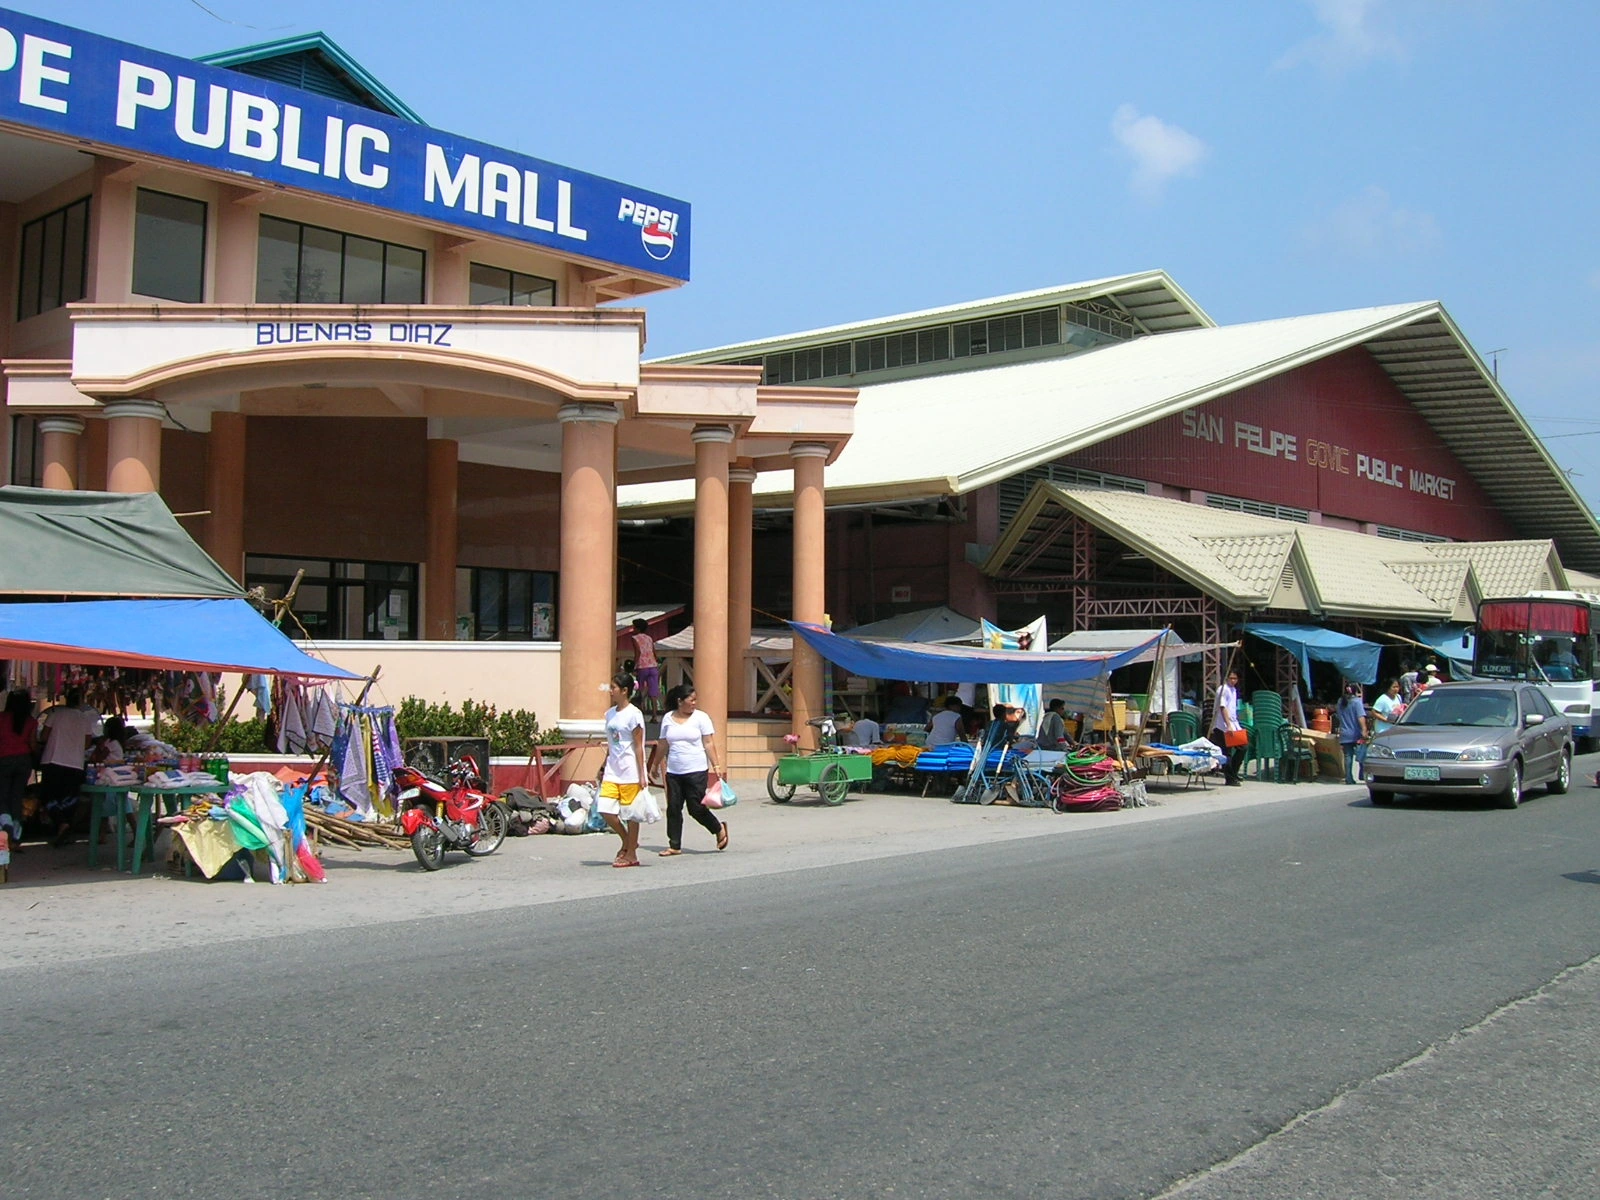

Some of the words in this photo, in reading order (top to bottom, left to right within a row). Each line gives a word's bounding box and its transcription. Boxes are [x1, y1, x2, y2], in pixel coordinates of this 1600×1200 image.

[116, 59, 390, 189] PUBLIC
[424, 143, 588, 241] MALL
[618, 197, 679, 236] PEPSI
[256, 322, 372, 346] BUENAS
[389, 323, 452, 347] DIAZ
[1182, 409, 1224, 444] SAN
[1234, 421, 1297, 461] FELIPE
[1357, 453, 1403, 488] PUBLIC
[1410, 468, 1456, 500] MARKET
